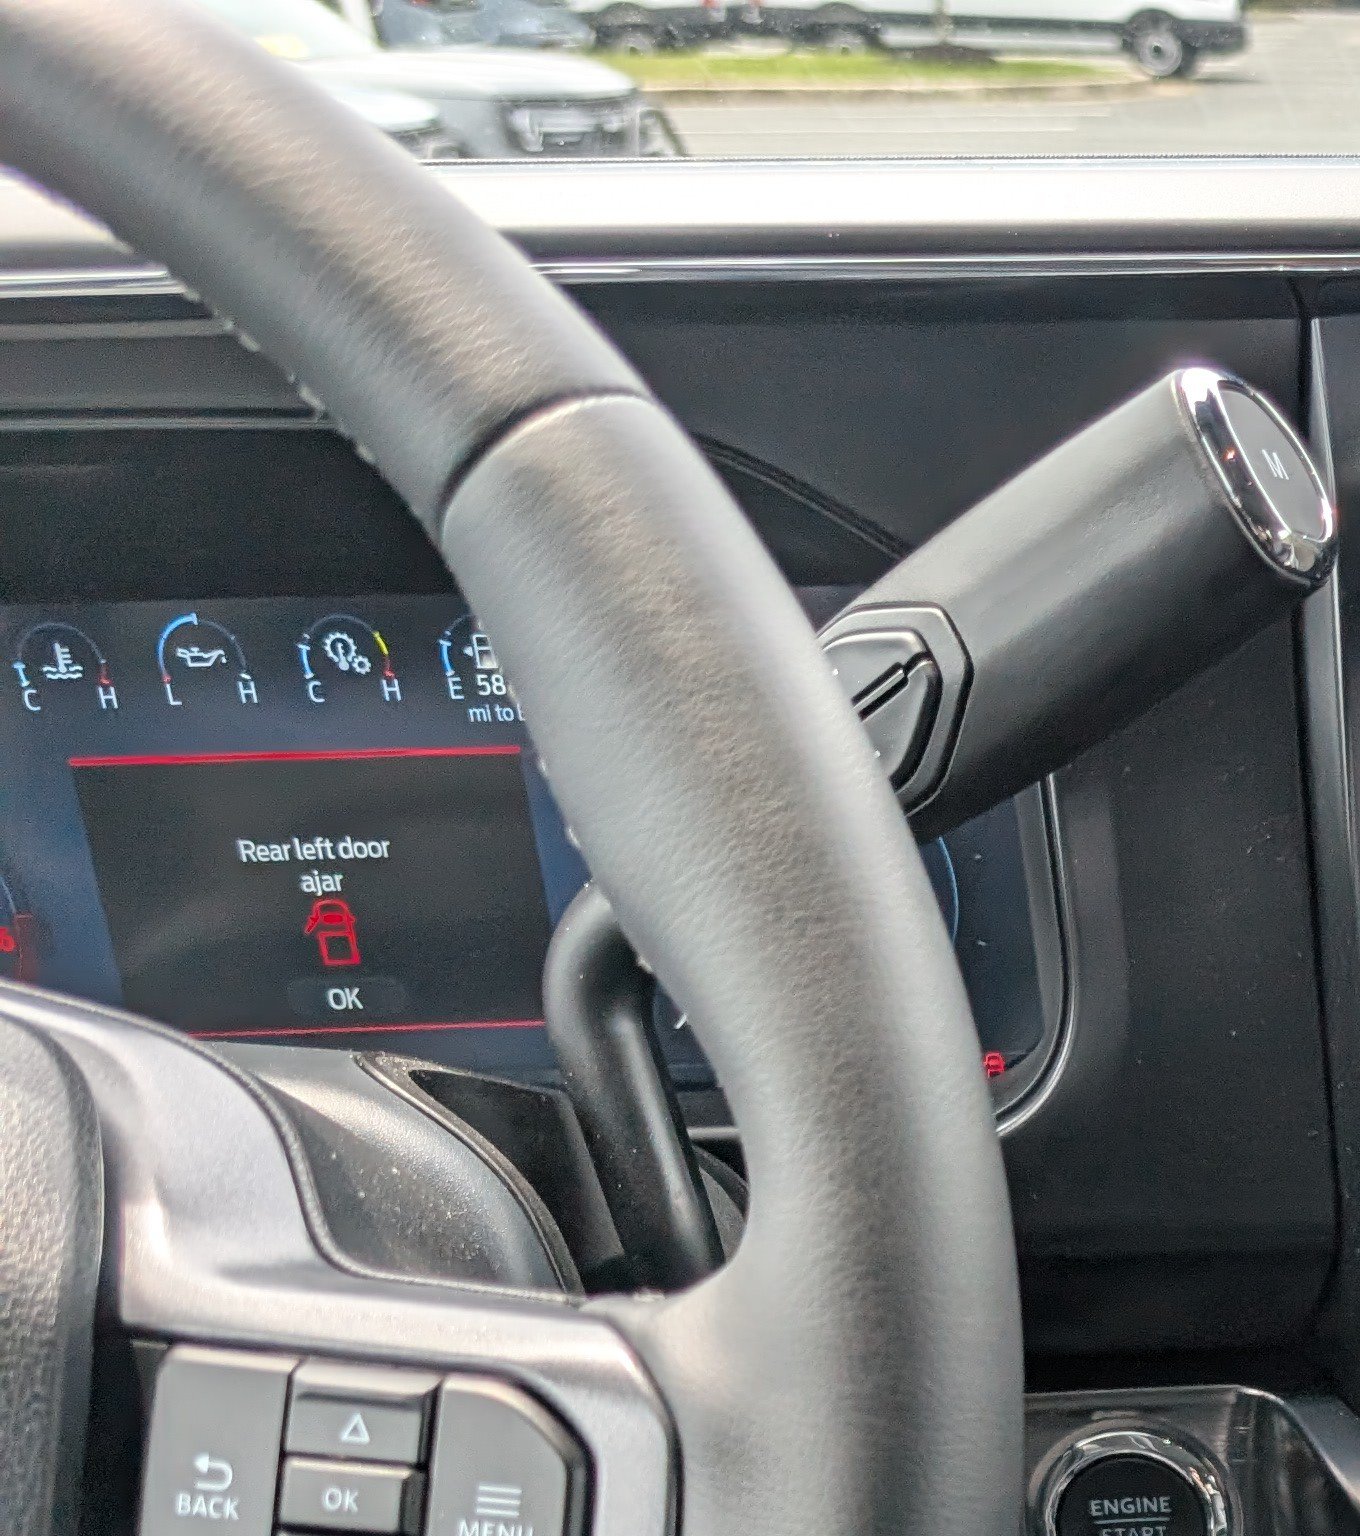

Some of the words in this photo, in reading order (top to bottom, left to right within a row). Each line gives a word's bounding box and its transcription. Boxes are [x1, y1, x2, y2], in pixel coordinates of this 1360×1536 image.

[22, 688, 42, 711] C
[100, 685, 119, 709] H
[167, 682, 182, 706] L
[239, 679, 257, 704] H
[307, 680, 325, 704] C
[381, 678, 402, 702] H
[448, 677, 465, 700] E
[468, 704, 492, 722] mi
[494, 704, 515, 722] to
[239, 840, 290, 863] Rear
[295, 836, 336, 861] left
[339, 835, 390, 860] door
[300, 870, 344, 894] ajar
[326, 986, 364, 1011] OK
[174, 1492, 240, 1521] BACK
[322, 1487, 360, 1513] OK
[1090, 1496, 1173, 1518] ENGINE
